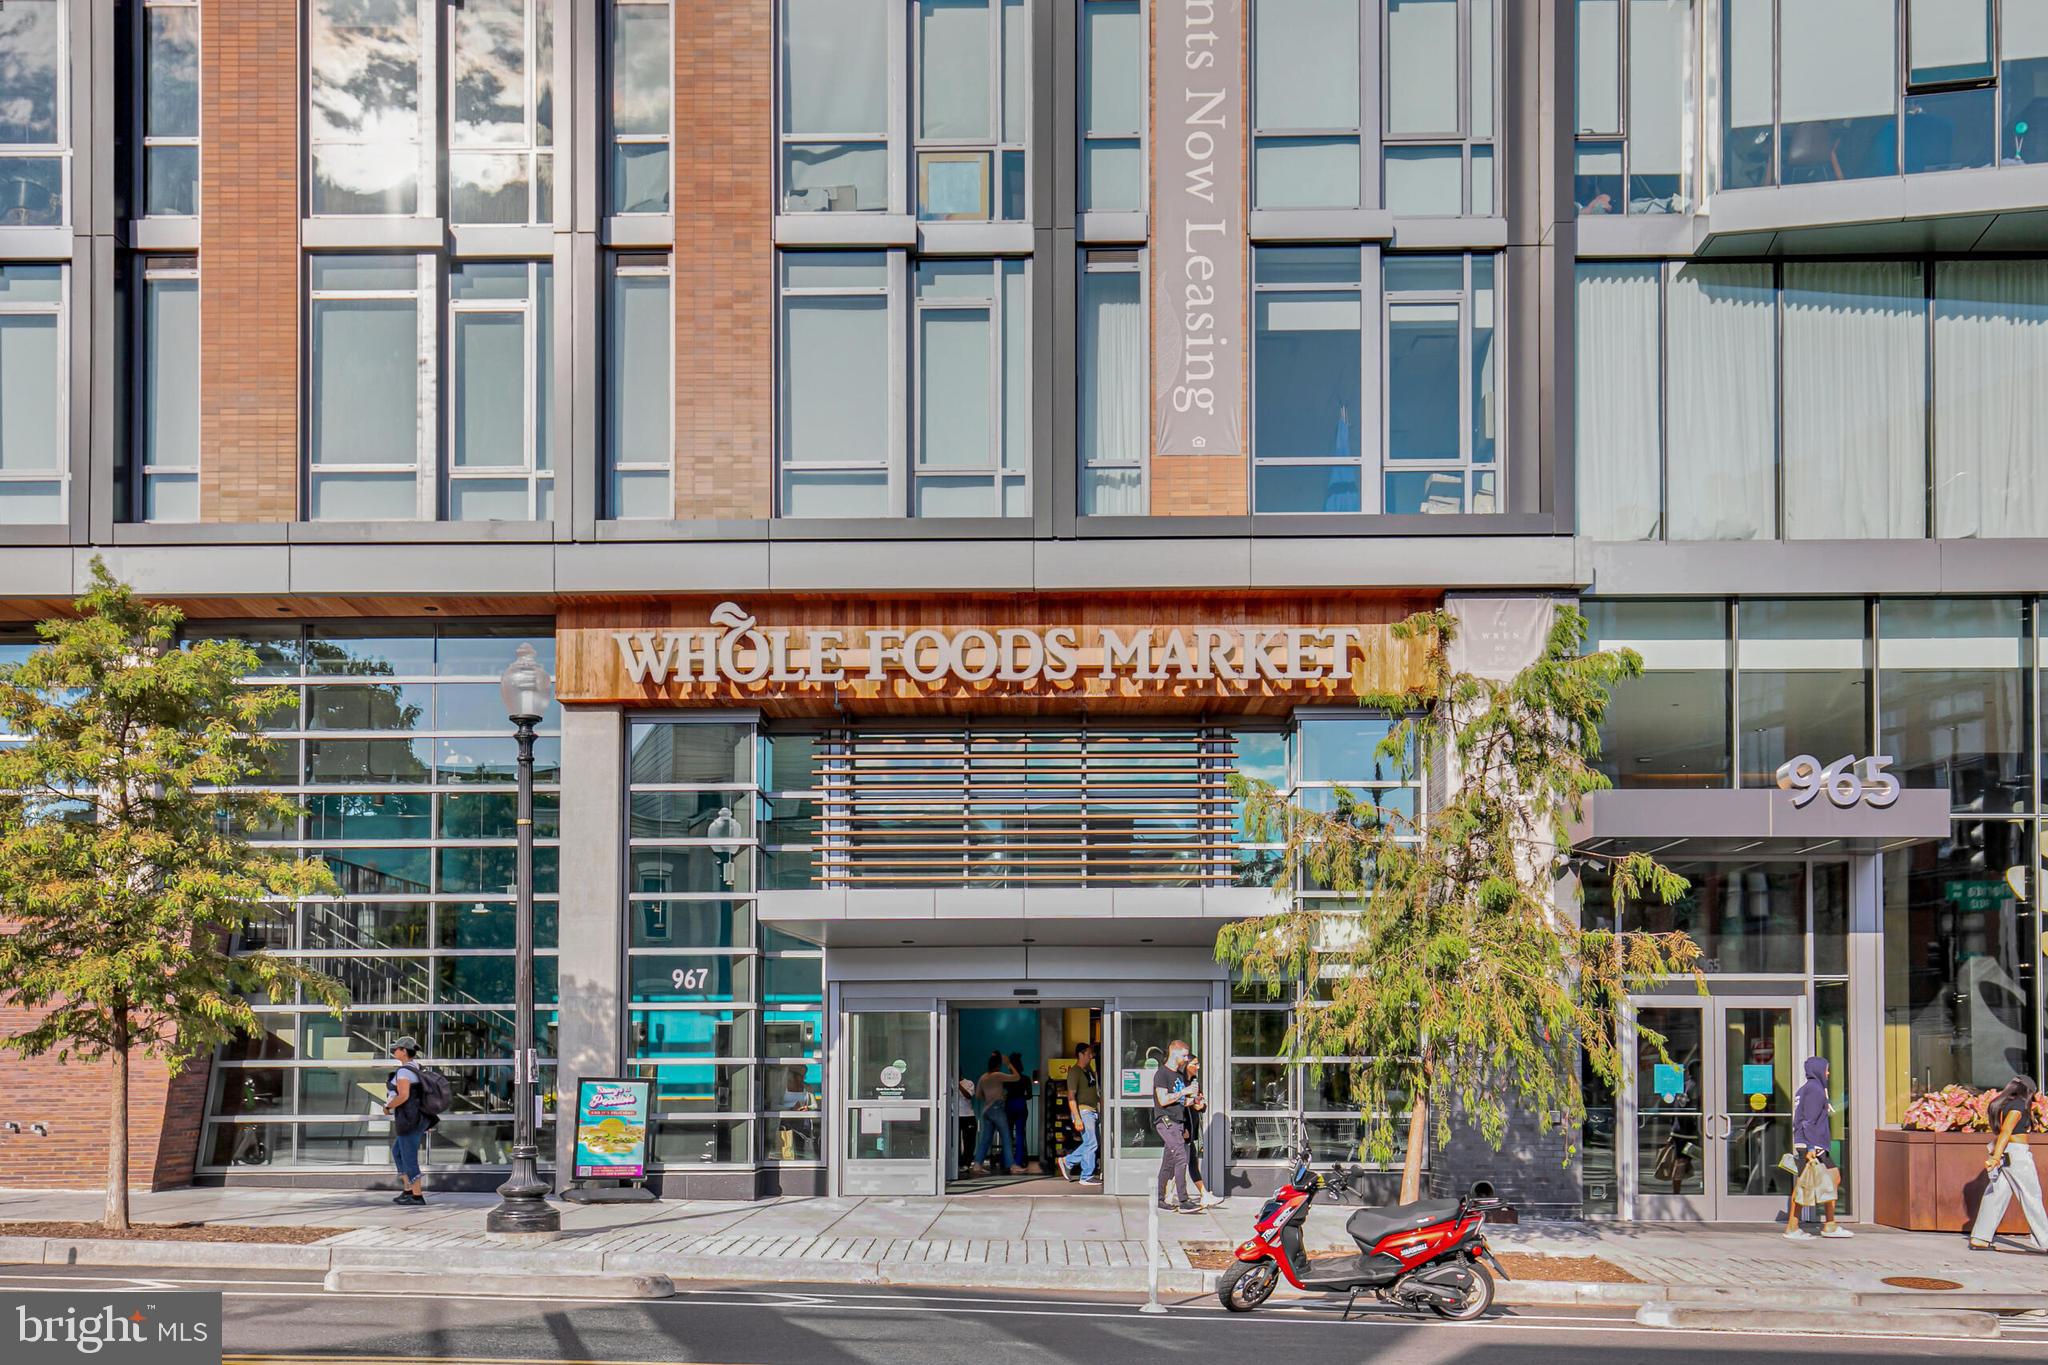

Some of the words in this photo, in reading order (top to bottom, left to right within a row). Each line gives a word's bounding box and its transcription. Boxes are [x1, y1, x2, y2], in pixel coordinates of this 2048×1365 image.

[1185, 88, 1226, 205] Now
[1173, 219, 1227, 415] Leasing
[612, 601, 844, 685] WHOLE
[865, 628, 1079, 682] FOODS
[1098, 627, 1360, 681] MARKET
[1787, 754, 1900, 808] 965
[672, 968, 709, 989] 967
